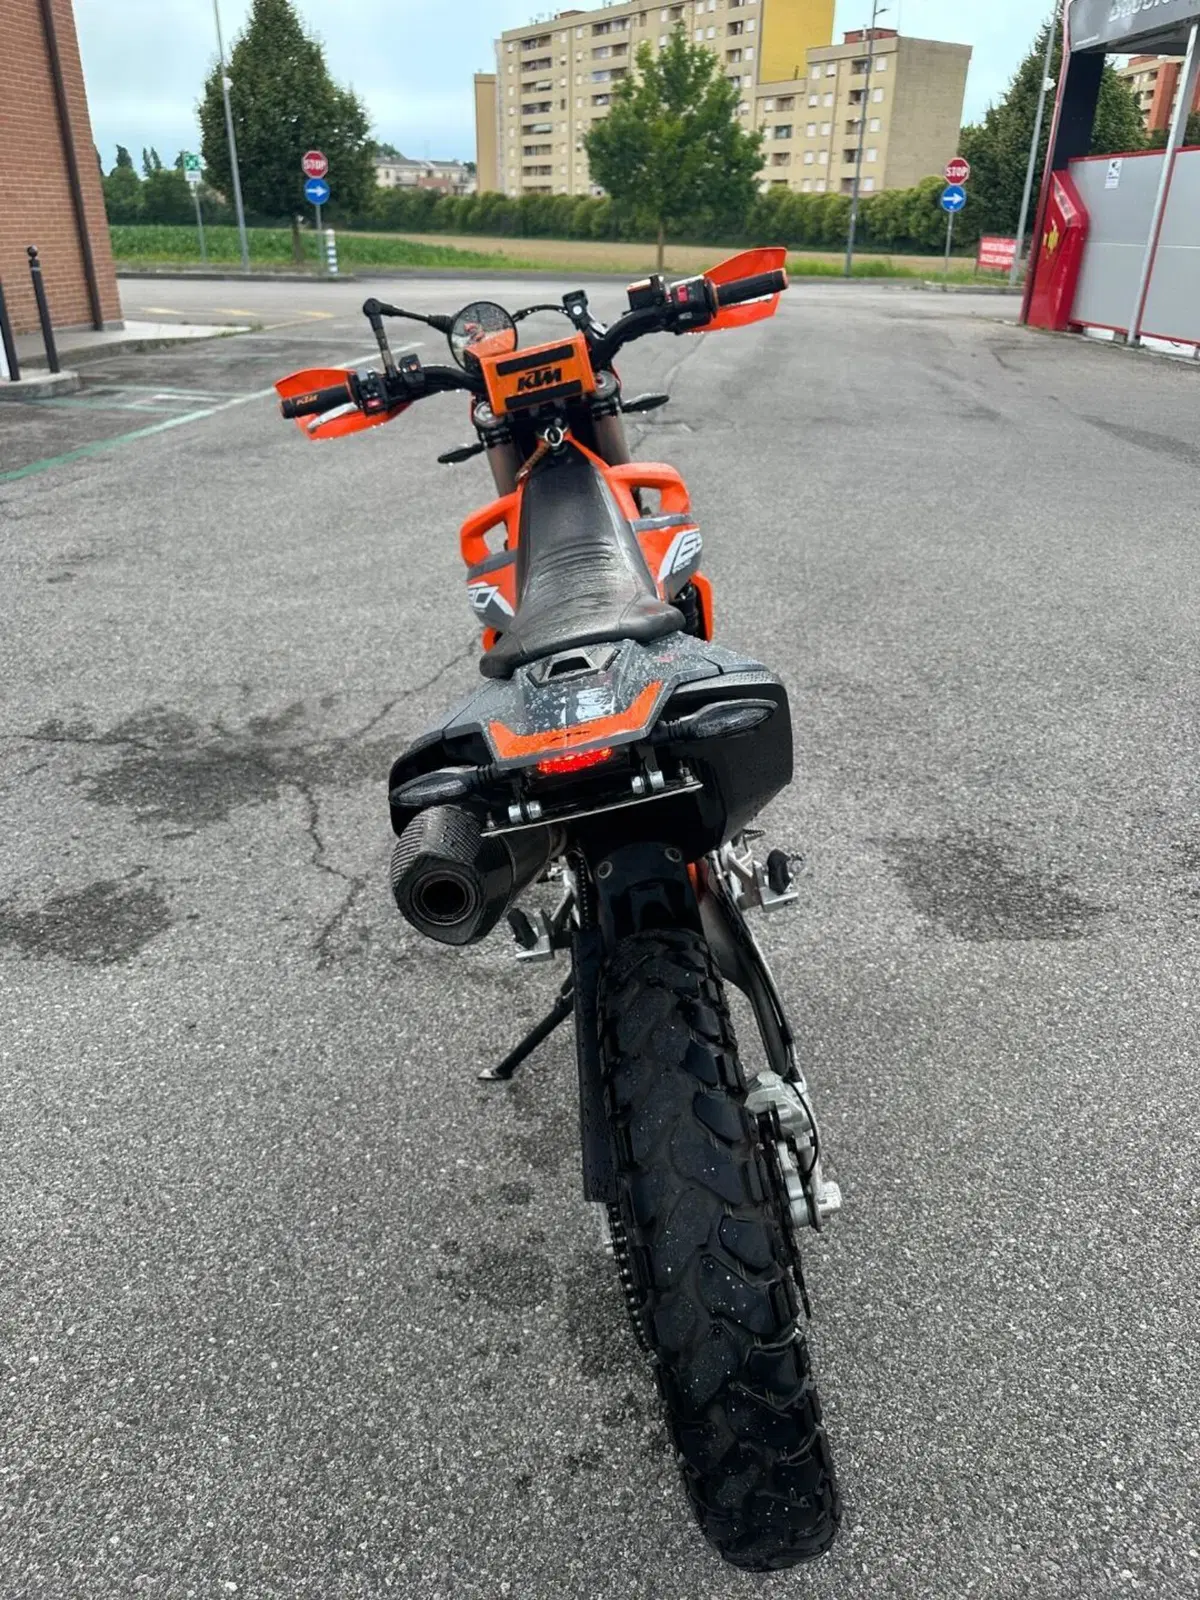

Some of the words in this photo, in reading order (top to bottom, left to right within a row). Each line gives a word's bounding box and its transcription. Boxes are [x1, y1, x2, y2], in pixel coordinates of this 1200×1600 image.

[303, 160, 326, 170] STOP
[946, 167, 967, 177] STOP
[517, 366, 562, 392] KTM
